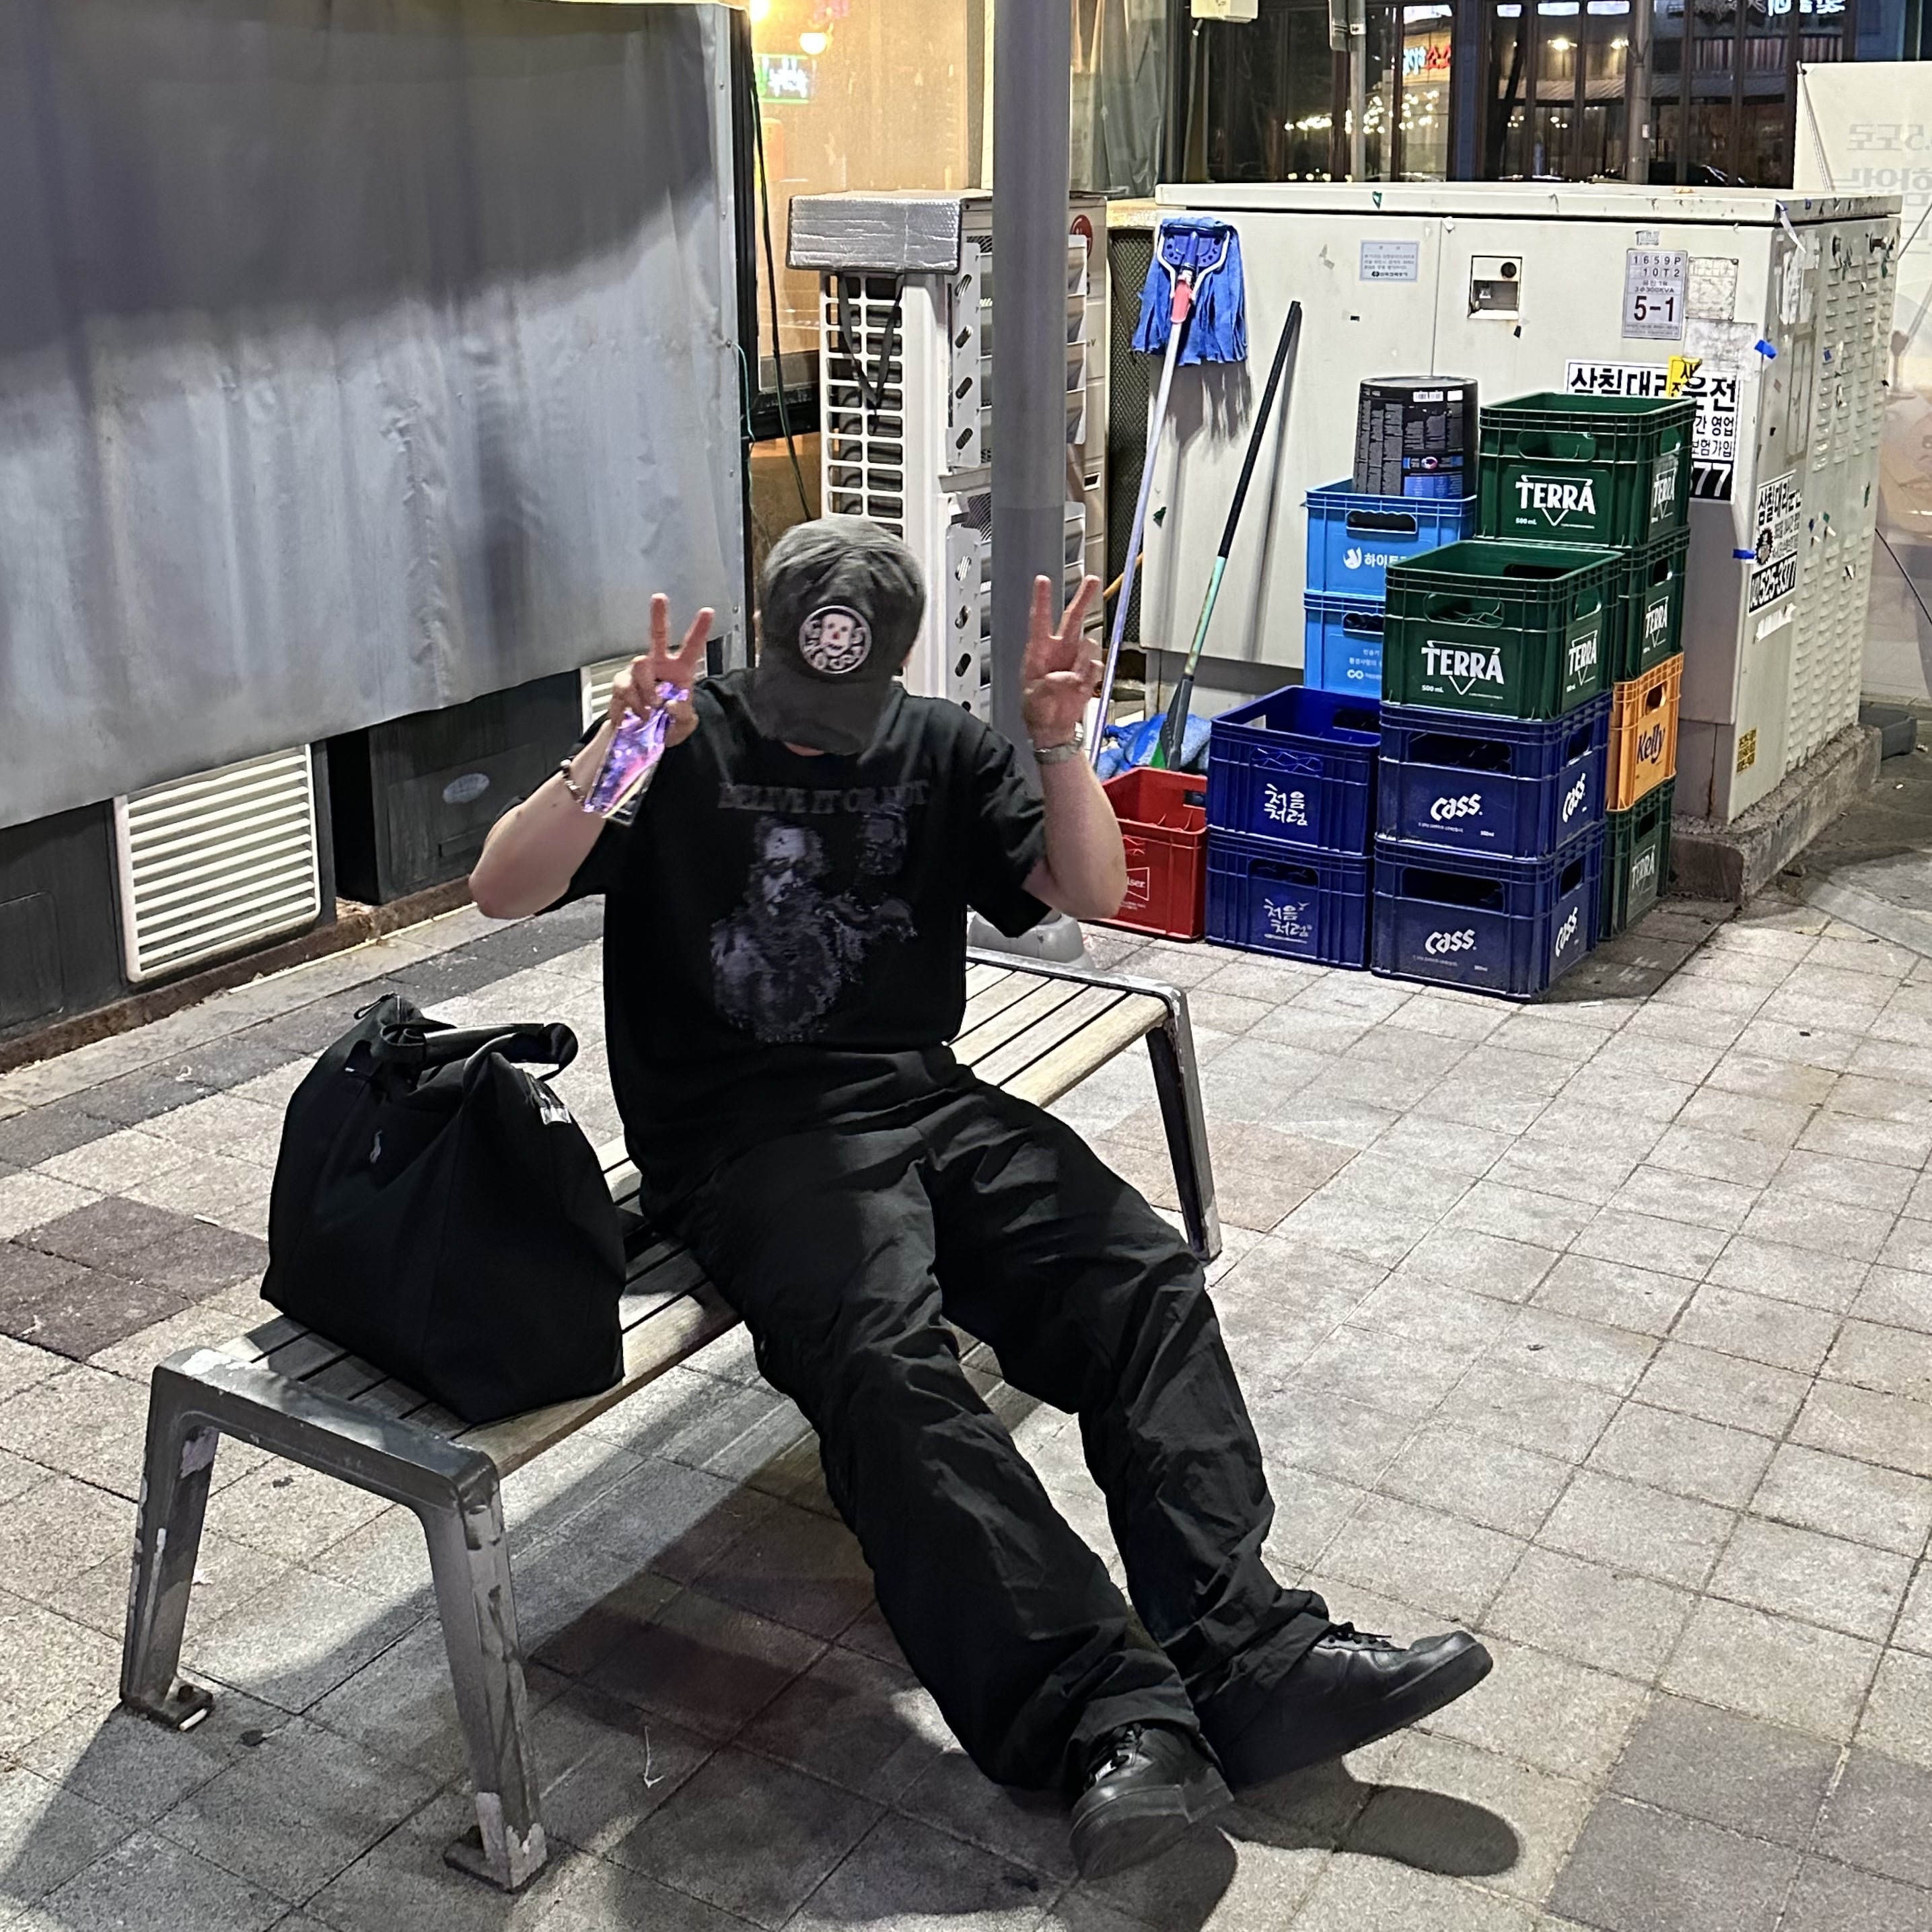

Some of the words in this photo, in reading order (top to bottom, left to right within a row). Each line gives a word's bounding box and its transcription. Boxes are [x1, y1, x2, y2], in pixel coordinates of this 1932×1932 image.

[1634, 295, 1674, 322] 5-1
[1712, 415, 1734, 437] 영업
[1653, 475, 1675, 508] TERRA
[1690, 462, 1731, 497] 77
[1515, 481, 1596, 515] TERRA
[1364, 552, 1407, 569] 하이트
[1645, 604, 1668, 639] TERRA
[1421, 647, 1505, 685] TERRA
[1569, 637, 1597, 676] TERRA
[1637, 722, 1666, 765] Kelly
[1264, 783, 1305, 810] 처음
[1263, 802, 1308, 826] 처럼
[1263, 898, 1298, 921] 처음
[1270, 919, 1309, 937] 처럼
